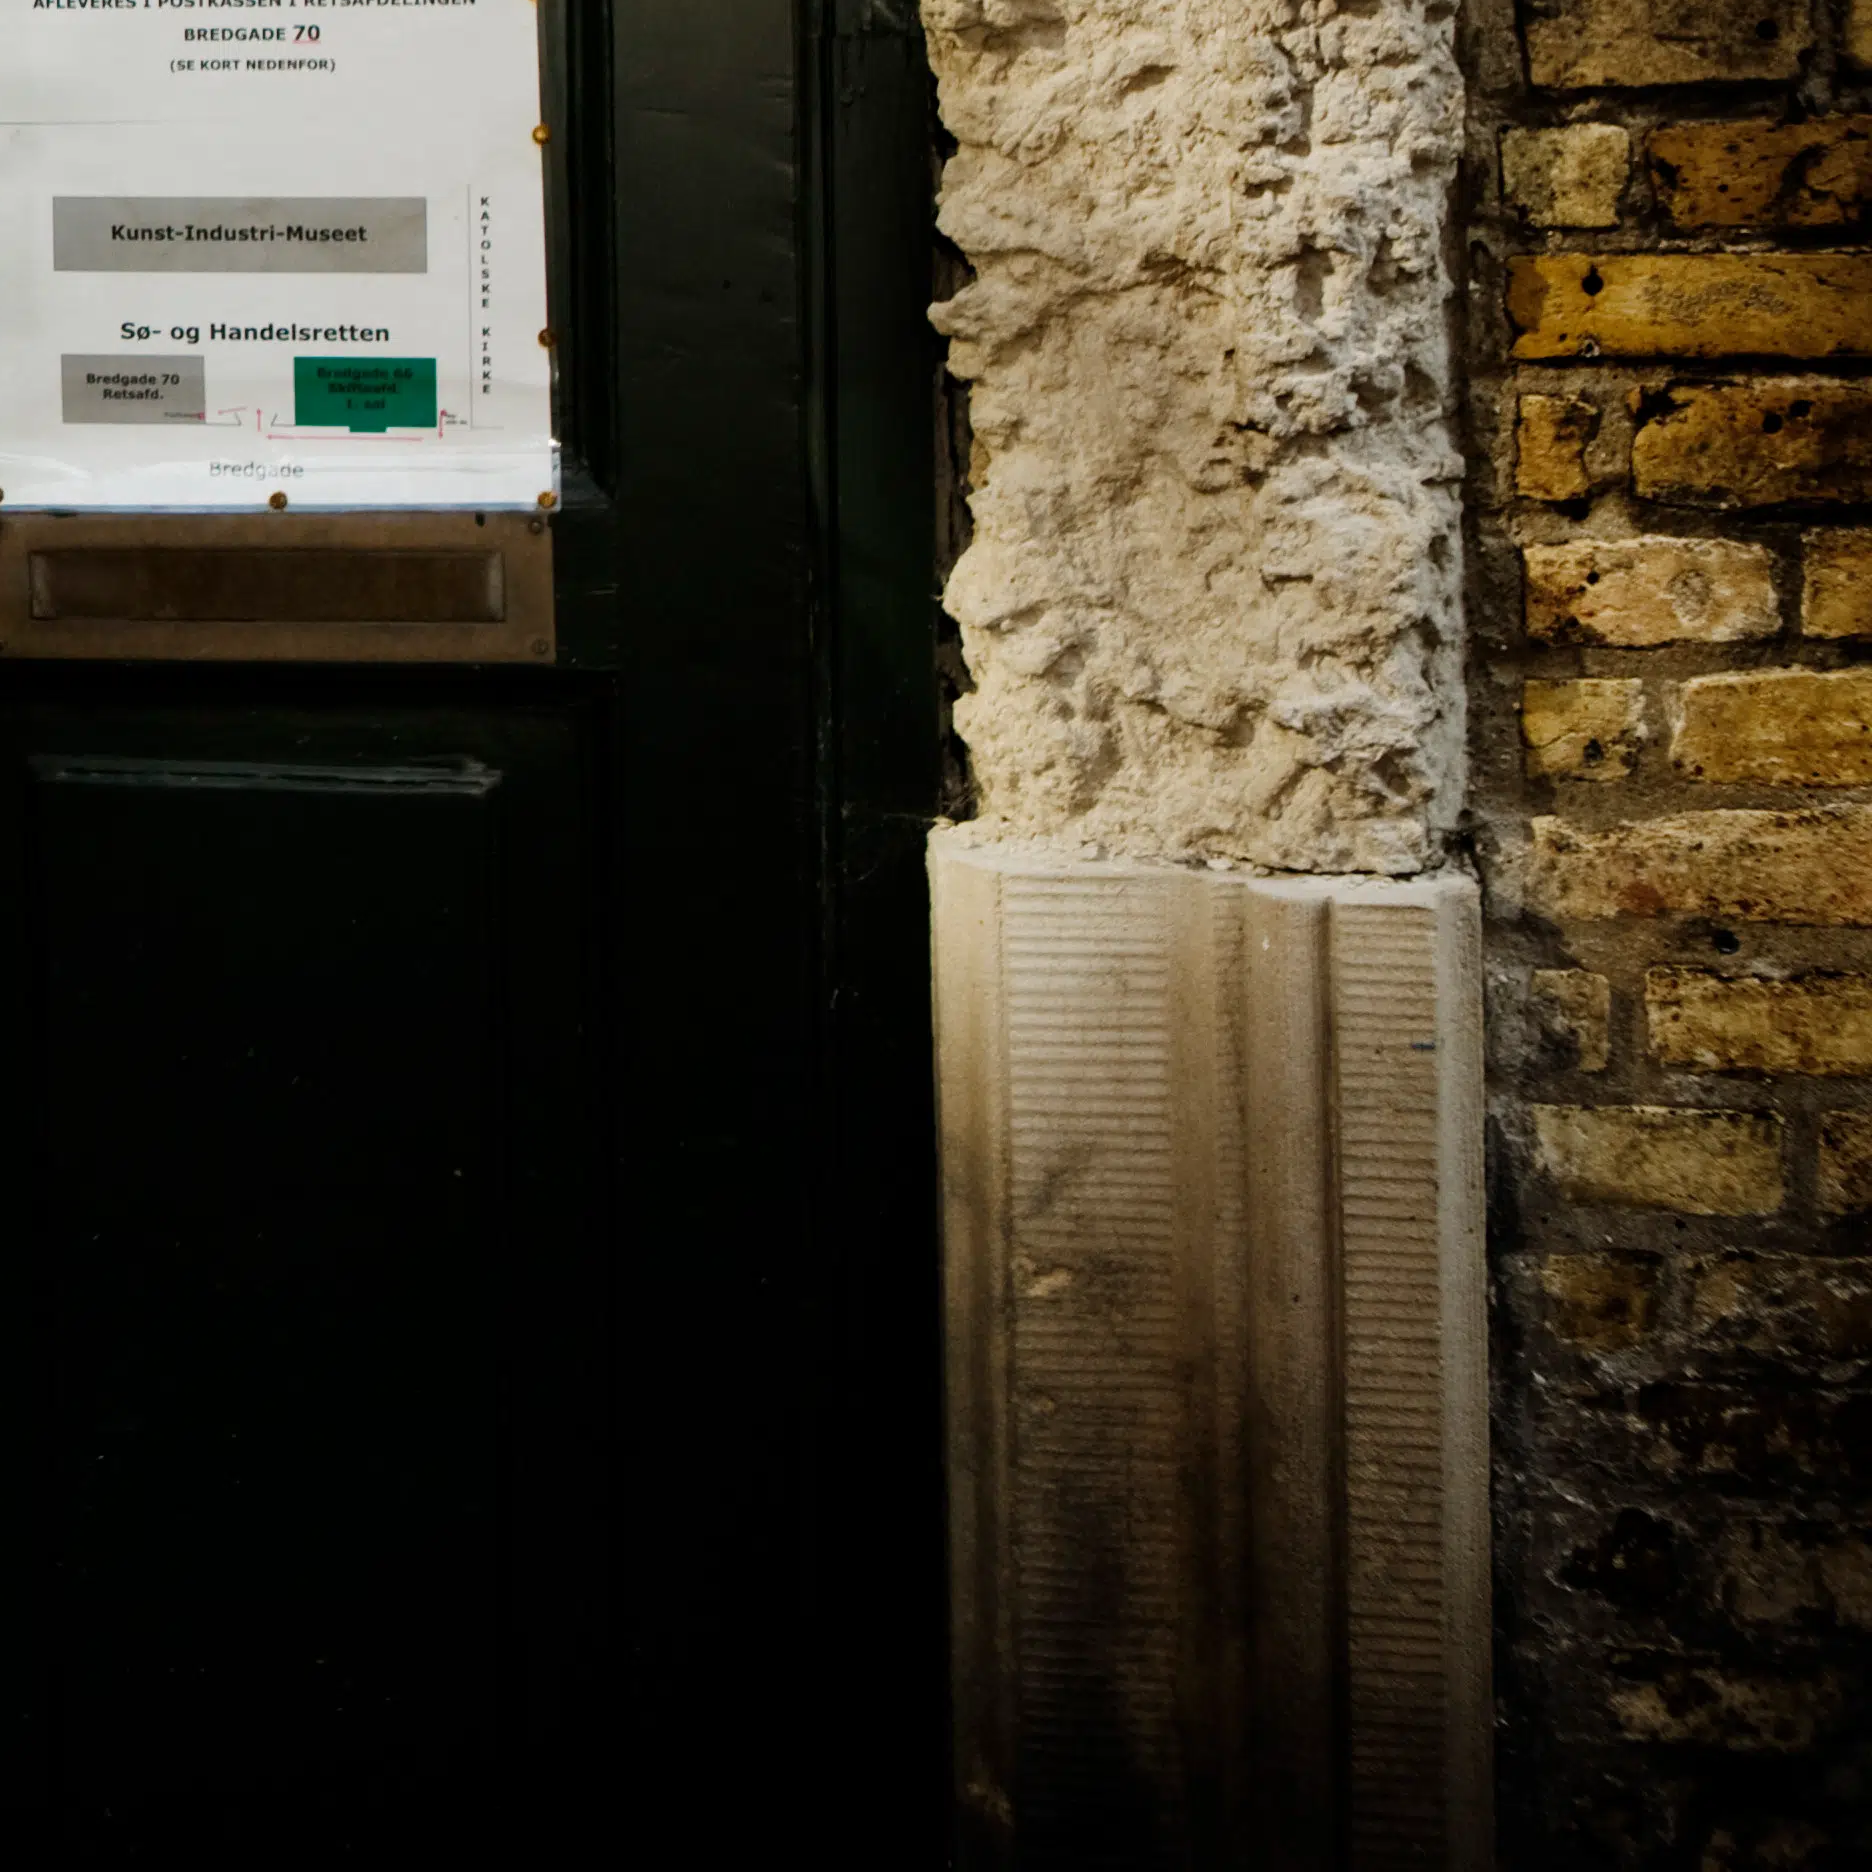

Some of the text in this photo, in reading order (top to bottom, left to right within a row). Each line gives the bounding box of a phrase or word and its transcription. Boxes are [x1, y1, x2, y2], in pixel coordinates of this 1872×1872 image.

[184, 24, 321, 42] BREDGADE 70
[169, 58, 337, 73] (SE KORT NEDENFOR)
[111, 224, 368, 243] Kunst-Industri-Museet
[480, 196, 492, 395] KATOLSKE KIRKE
[120, 321, 390, 344] Sø- og Handelsretten
[86, 372, 181, 387] Bredgade 70
[316, 367, 389, 382] Bredgade
[102, 387, 165, 401] Retsafd.
[209, 461, 305, 481] Bredgade
